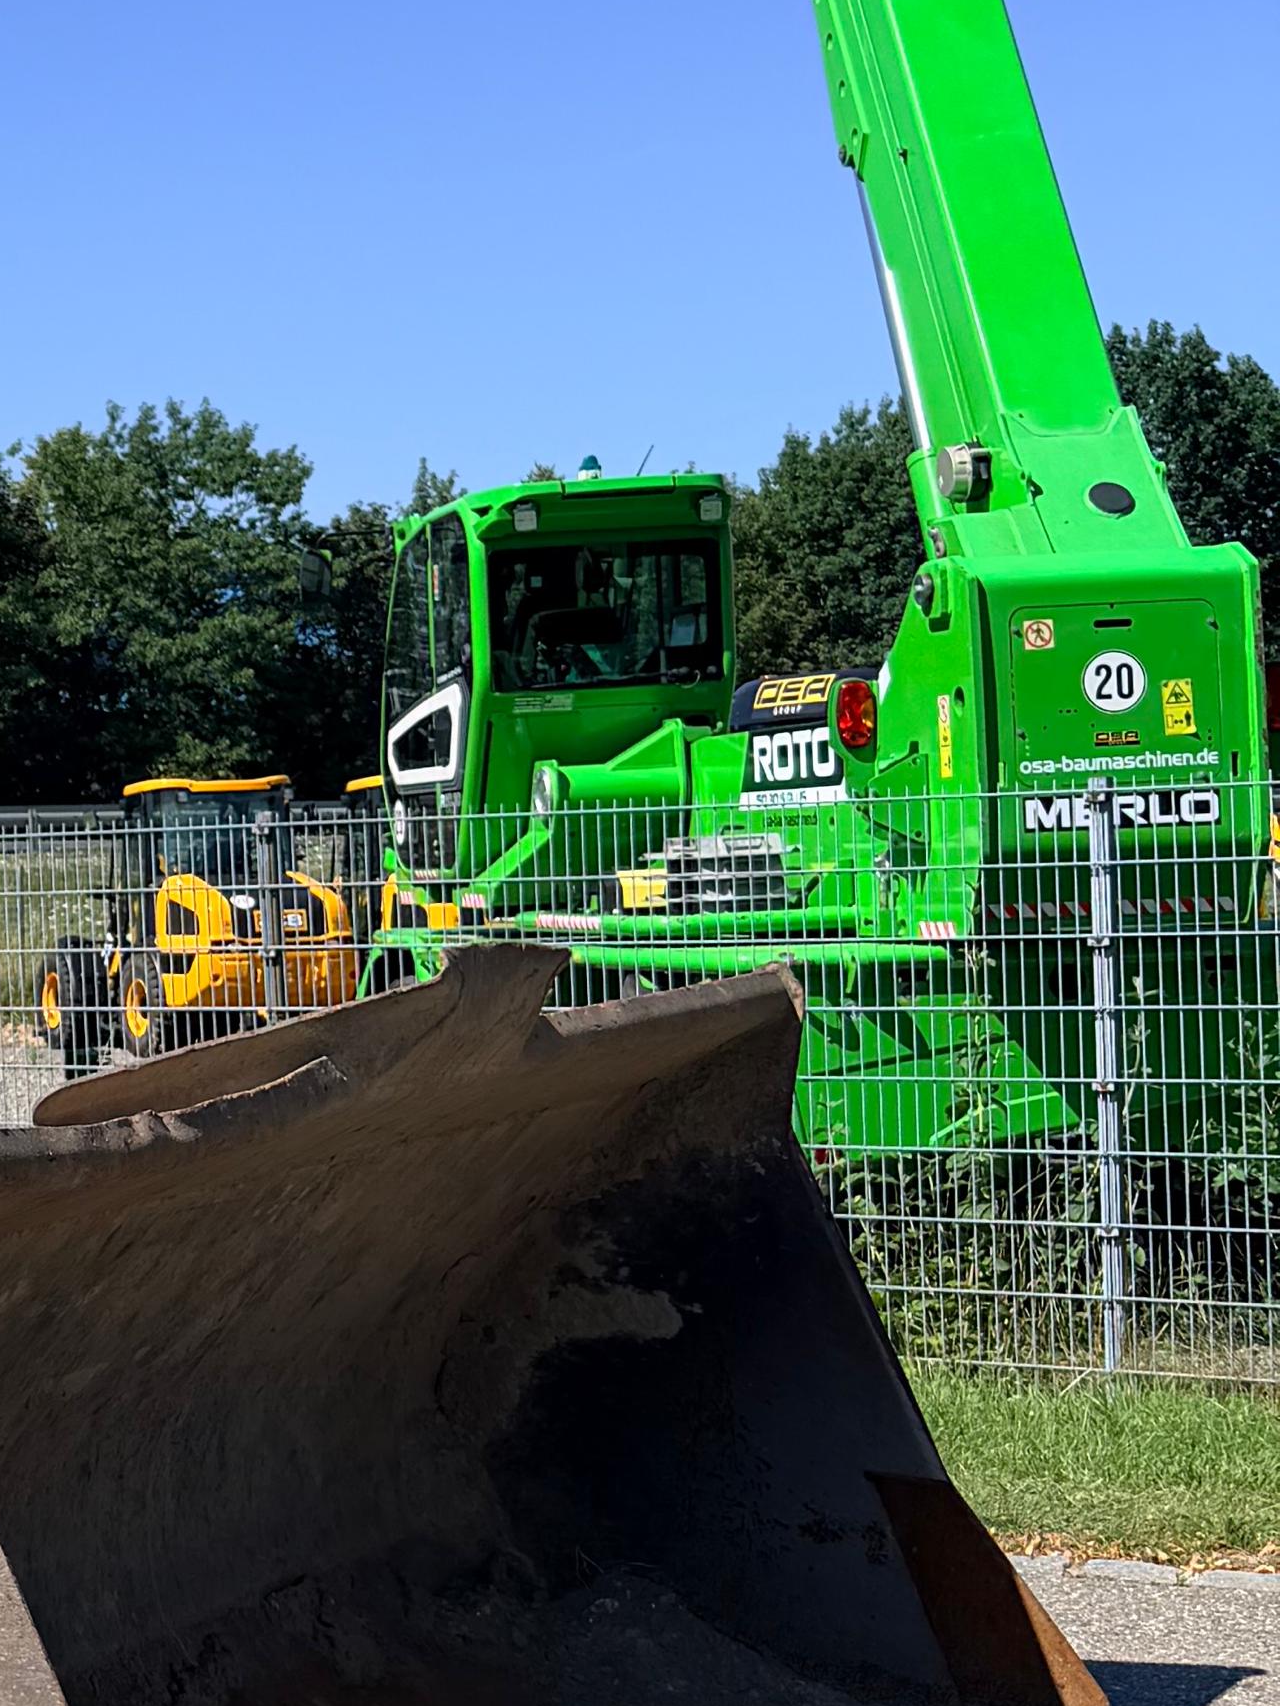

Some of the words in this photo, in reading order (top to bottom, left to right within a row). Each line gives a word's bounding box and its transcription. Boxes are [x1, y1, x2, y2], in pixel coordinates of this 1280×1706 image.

[755, 675, 835, 707] OSA
[1094, 662, 1134, 700] 20
[752, 727, 836, 784] ROTO
[1019, 747, 1220, 775] osa-baumaschinen.de
